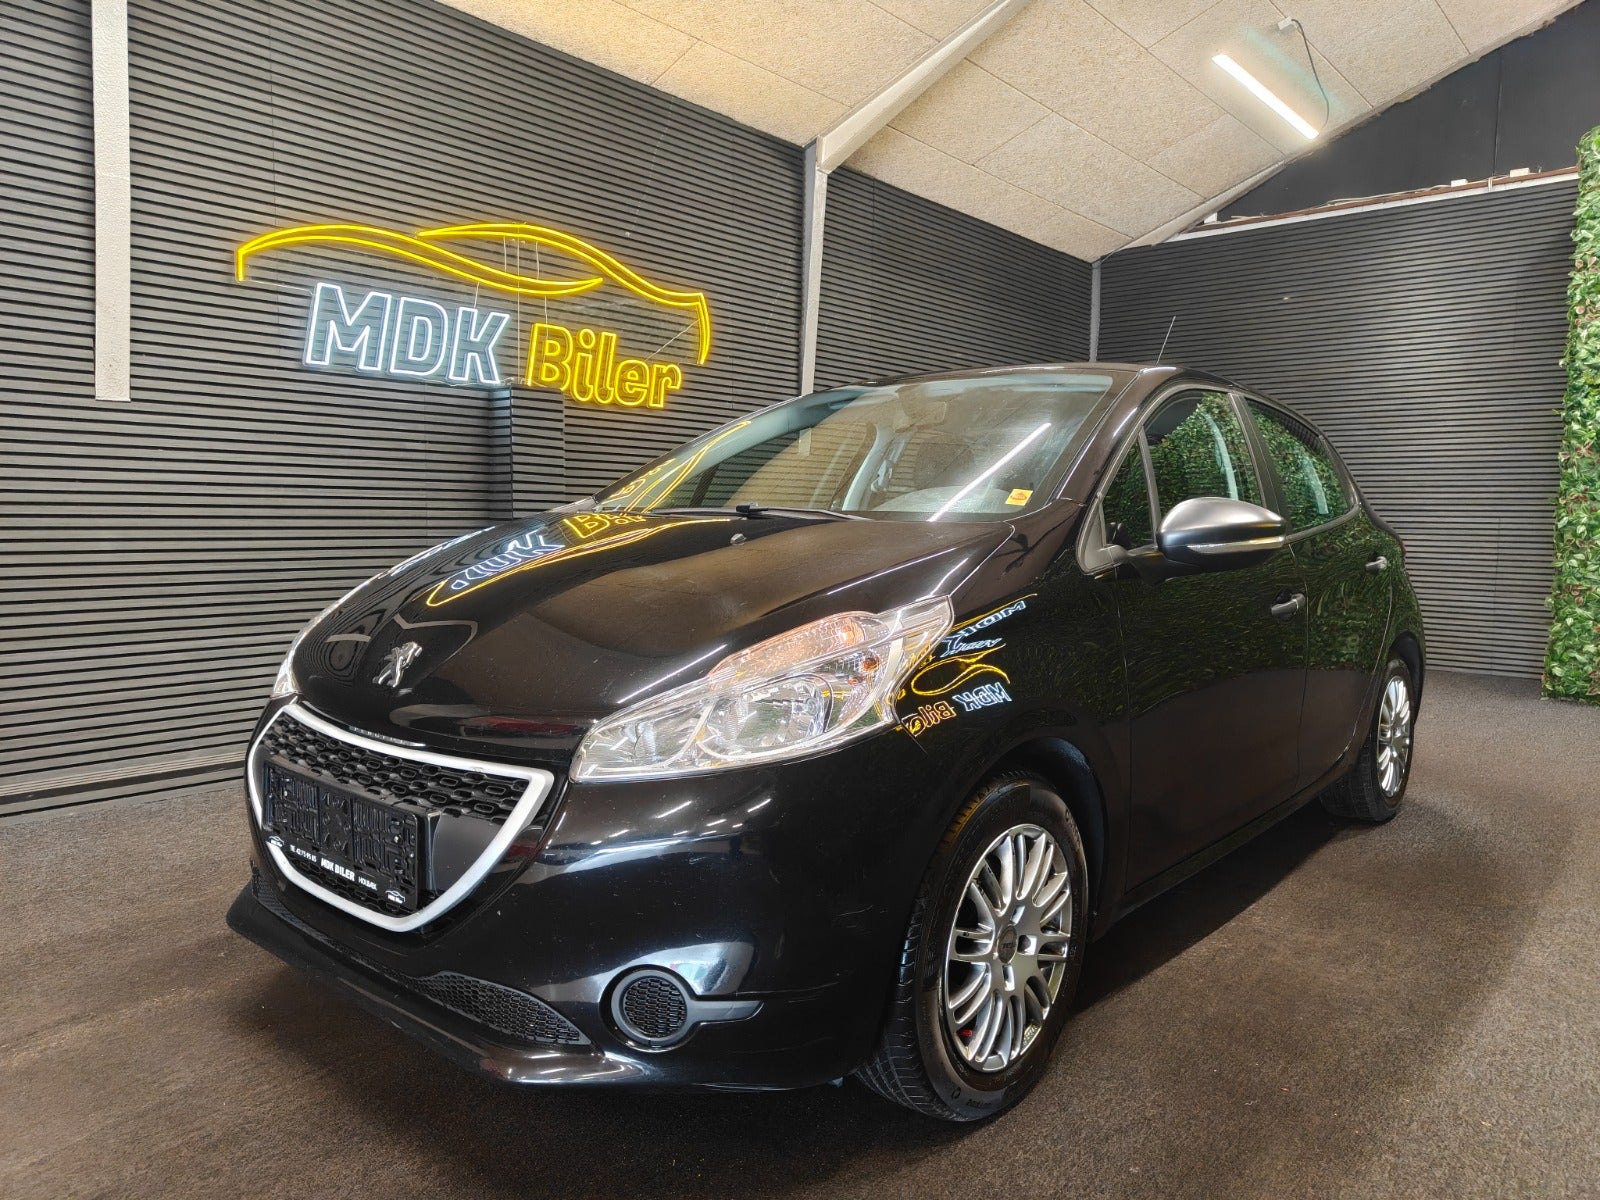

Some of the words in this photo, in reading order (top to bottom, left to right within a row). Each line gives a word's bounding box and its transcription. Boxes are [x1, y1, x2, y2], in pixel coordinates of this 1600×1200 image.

[304, 282, 510, 384] MDK
[527, 322, 682, 408] Biler
[334, 863, 355, 882] BILER
